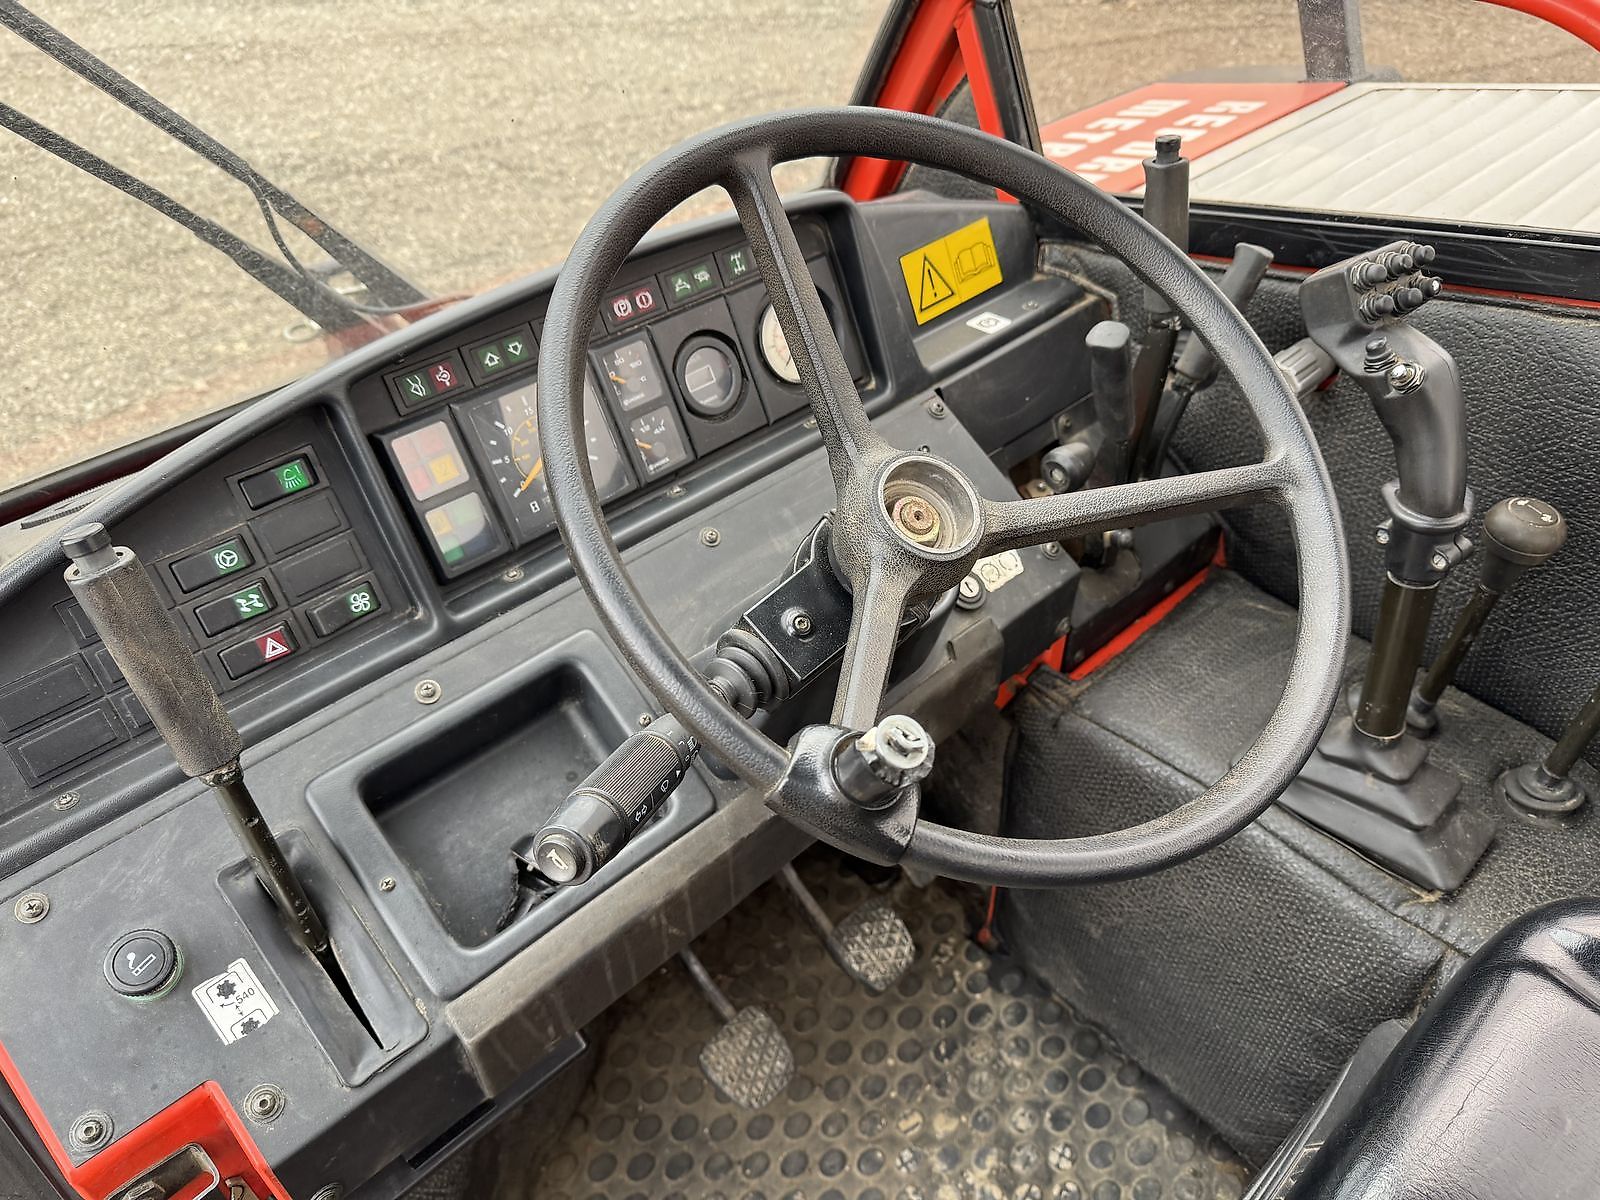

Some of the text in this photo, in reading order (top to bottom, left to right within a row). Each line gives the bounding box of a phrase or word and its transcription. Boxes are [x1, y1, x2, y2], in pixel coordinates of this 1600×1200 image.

[524, 407, 534, 416] 15
[504, 427, 514, 437] 10
[504, 455, 511, 464] 5
[235, 987, 255, 1004] 540
